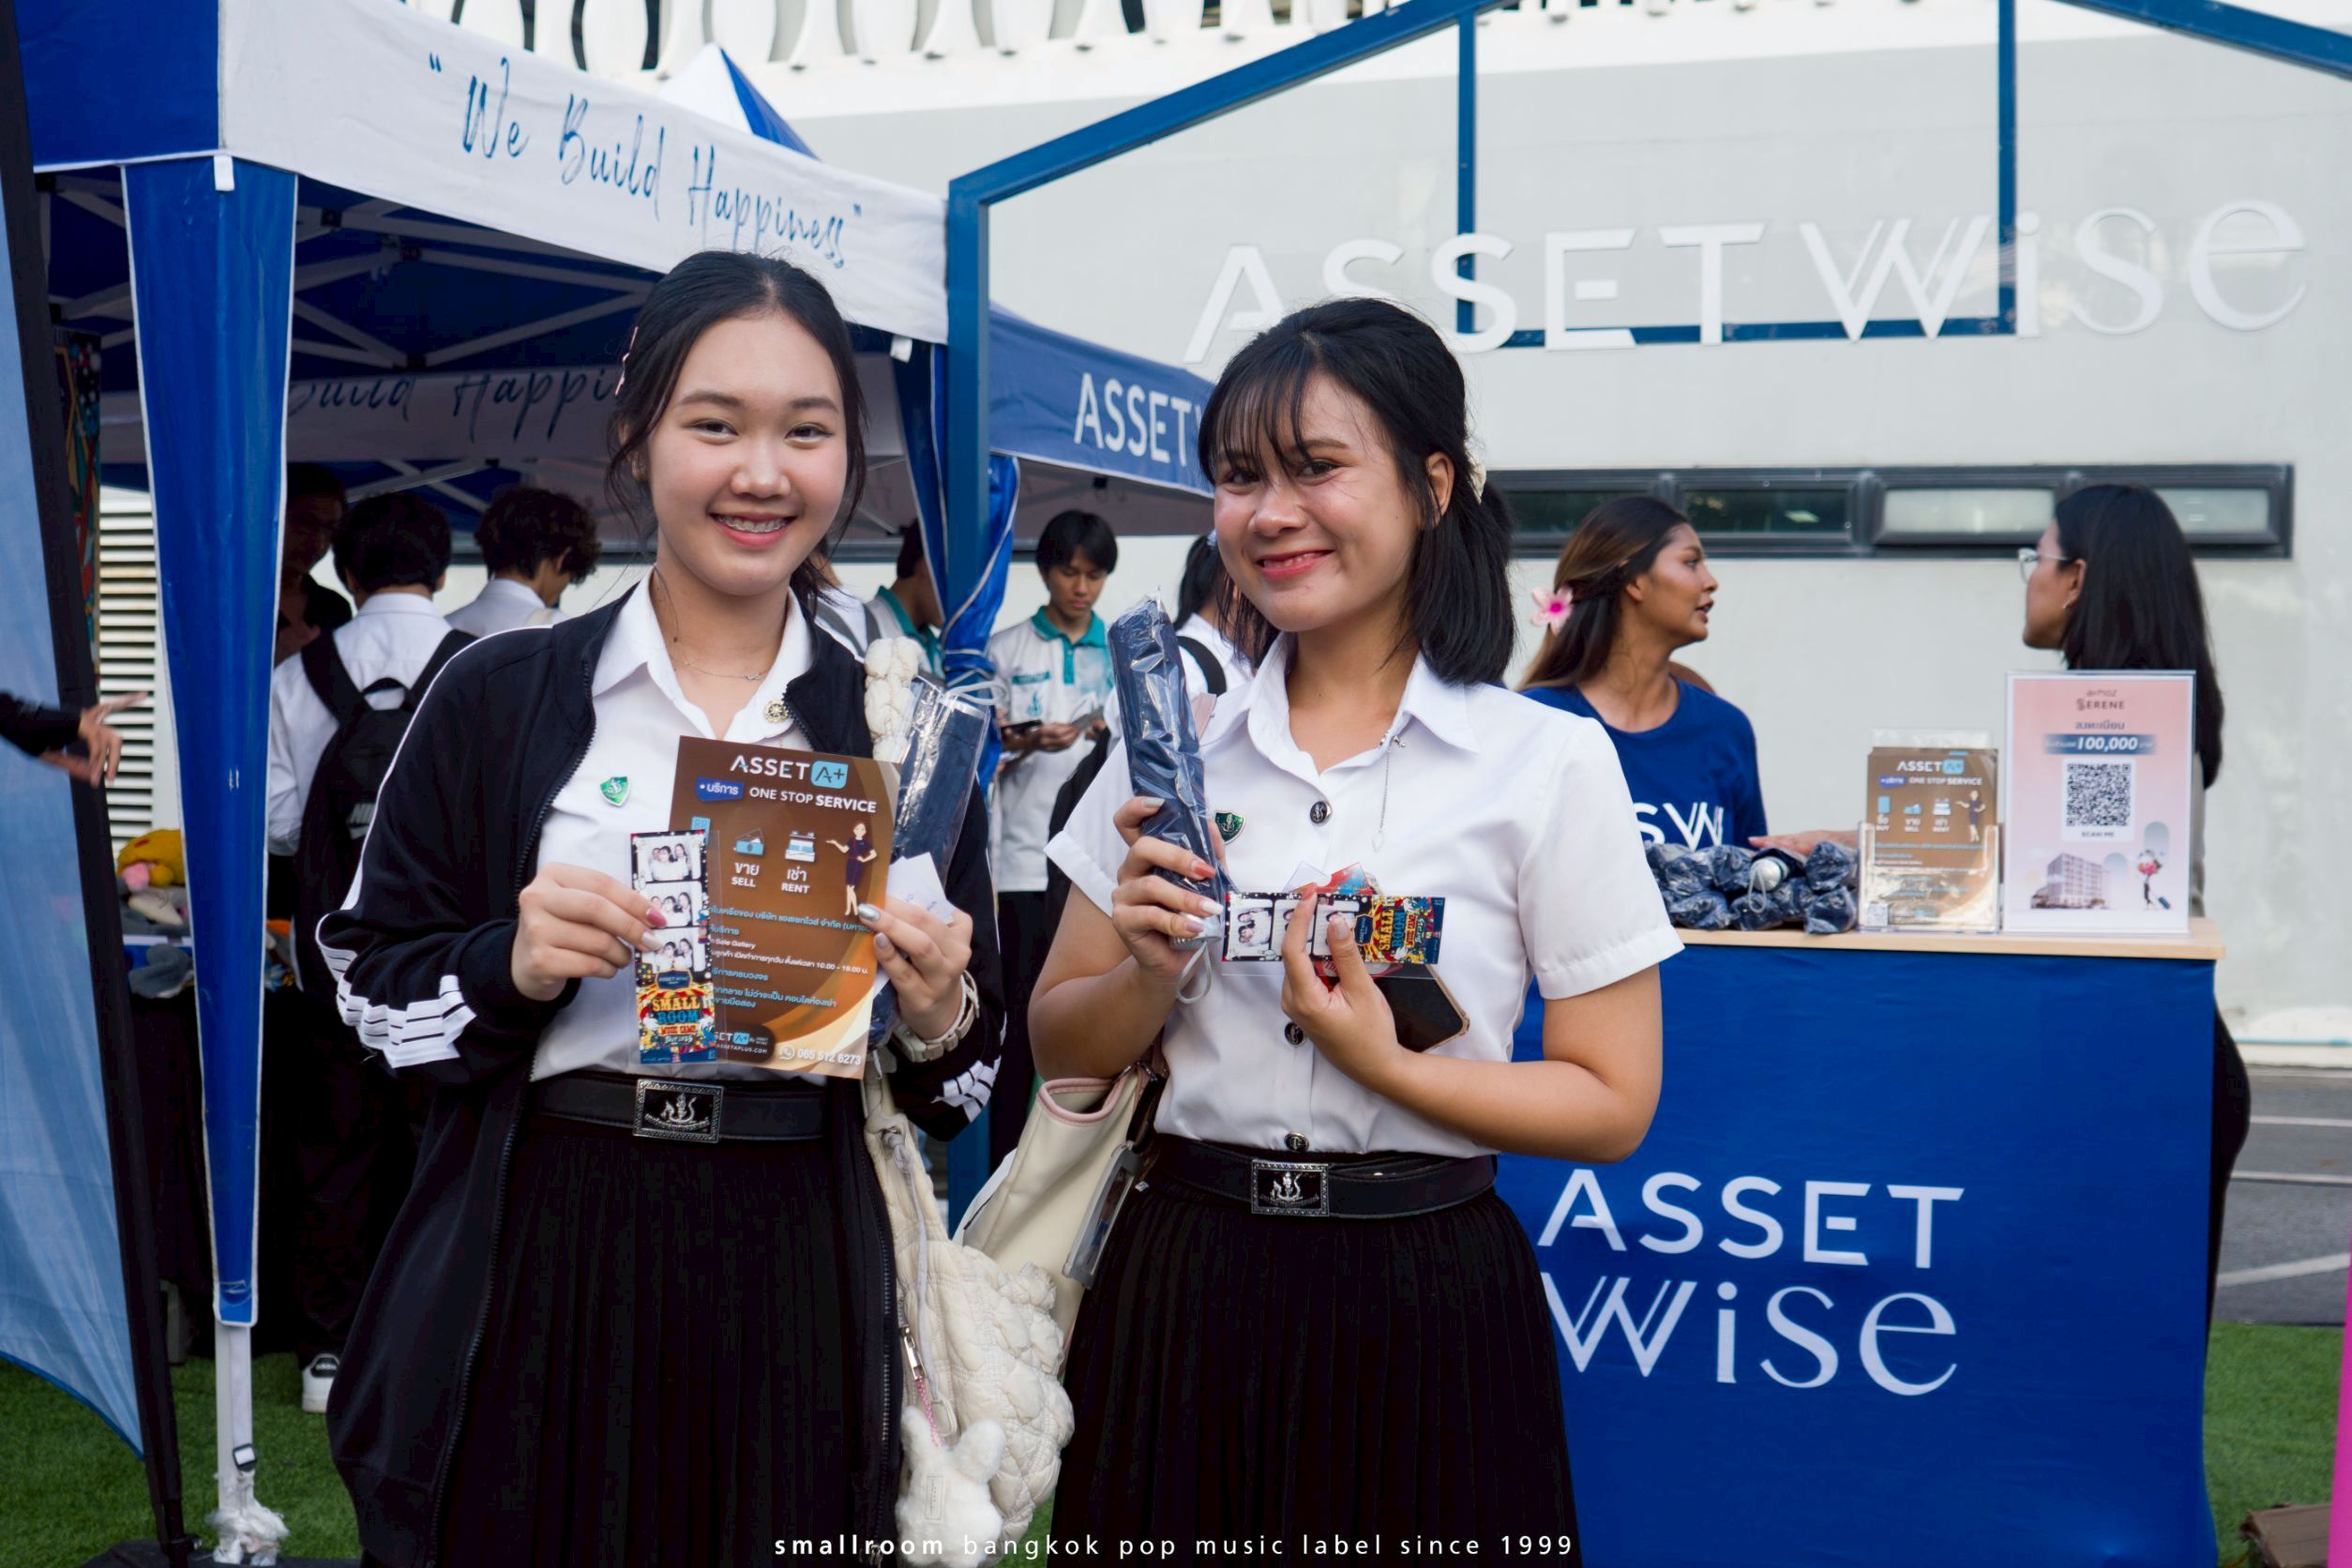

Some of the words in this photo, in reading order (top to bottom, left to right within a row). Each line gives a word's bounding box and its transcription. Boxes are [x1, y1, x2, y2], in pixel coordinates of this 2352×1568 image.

[559, 92, 666, 221] Build
[1074, 372, 1192, 467] ASSET
[2076, 698, 2126, 712] SERENE
[2077, 736, 2138, 752] 100,000
[730, 754, 811, 780] ASSET
[814, 765, 845, 784] A+
[1896, 760, 1942, 772] ASSET
[706, 781, 739, 795] บริการ
[1908, 776, 1925, 785] ONE
[1926, 776, 1946, 785] STOP
[1947, 776, 1983, 786] SERVICE
[748, 787, 777, 800] ONE
[780, 790, 813, 804] STOP
[815, 794, 877, 813] SERVICE
[734, 862, 760, 876] ขาย
[786, 866, 807, 882] เช่า
[731, 876, 756, 888] SELL
[781, 882, 810, 894] RENT
[1379, 909, 1395, 951] SMALL
[1392, 912, 1406, 948] ROOM
[817, 961, 836, 971] 10.00
[652, 996, 700, 1012] SMALL
[656, 1010, 699, 1024] ROOM
[817, 1050, 835, 1063] 512
[837, 1052, 862, 1065] 6273
[1537, 1168, 1965, 1269] ASSET
